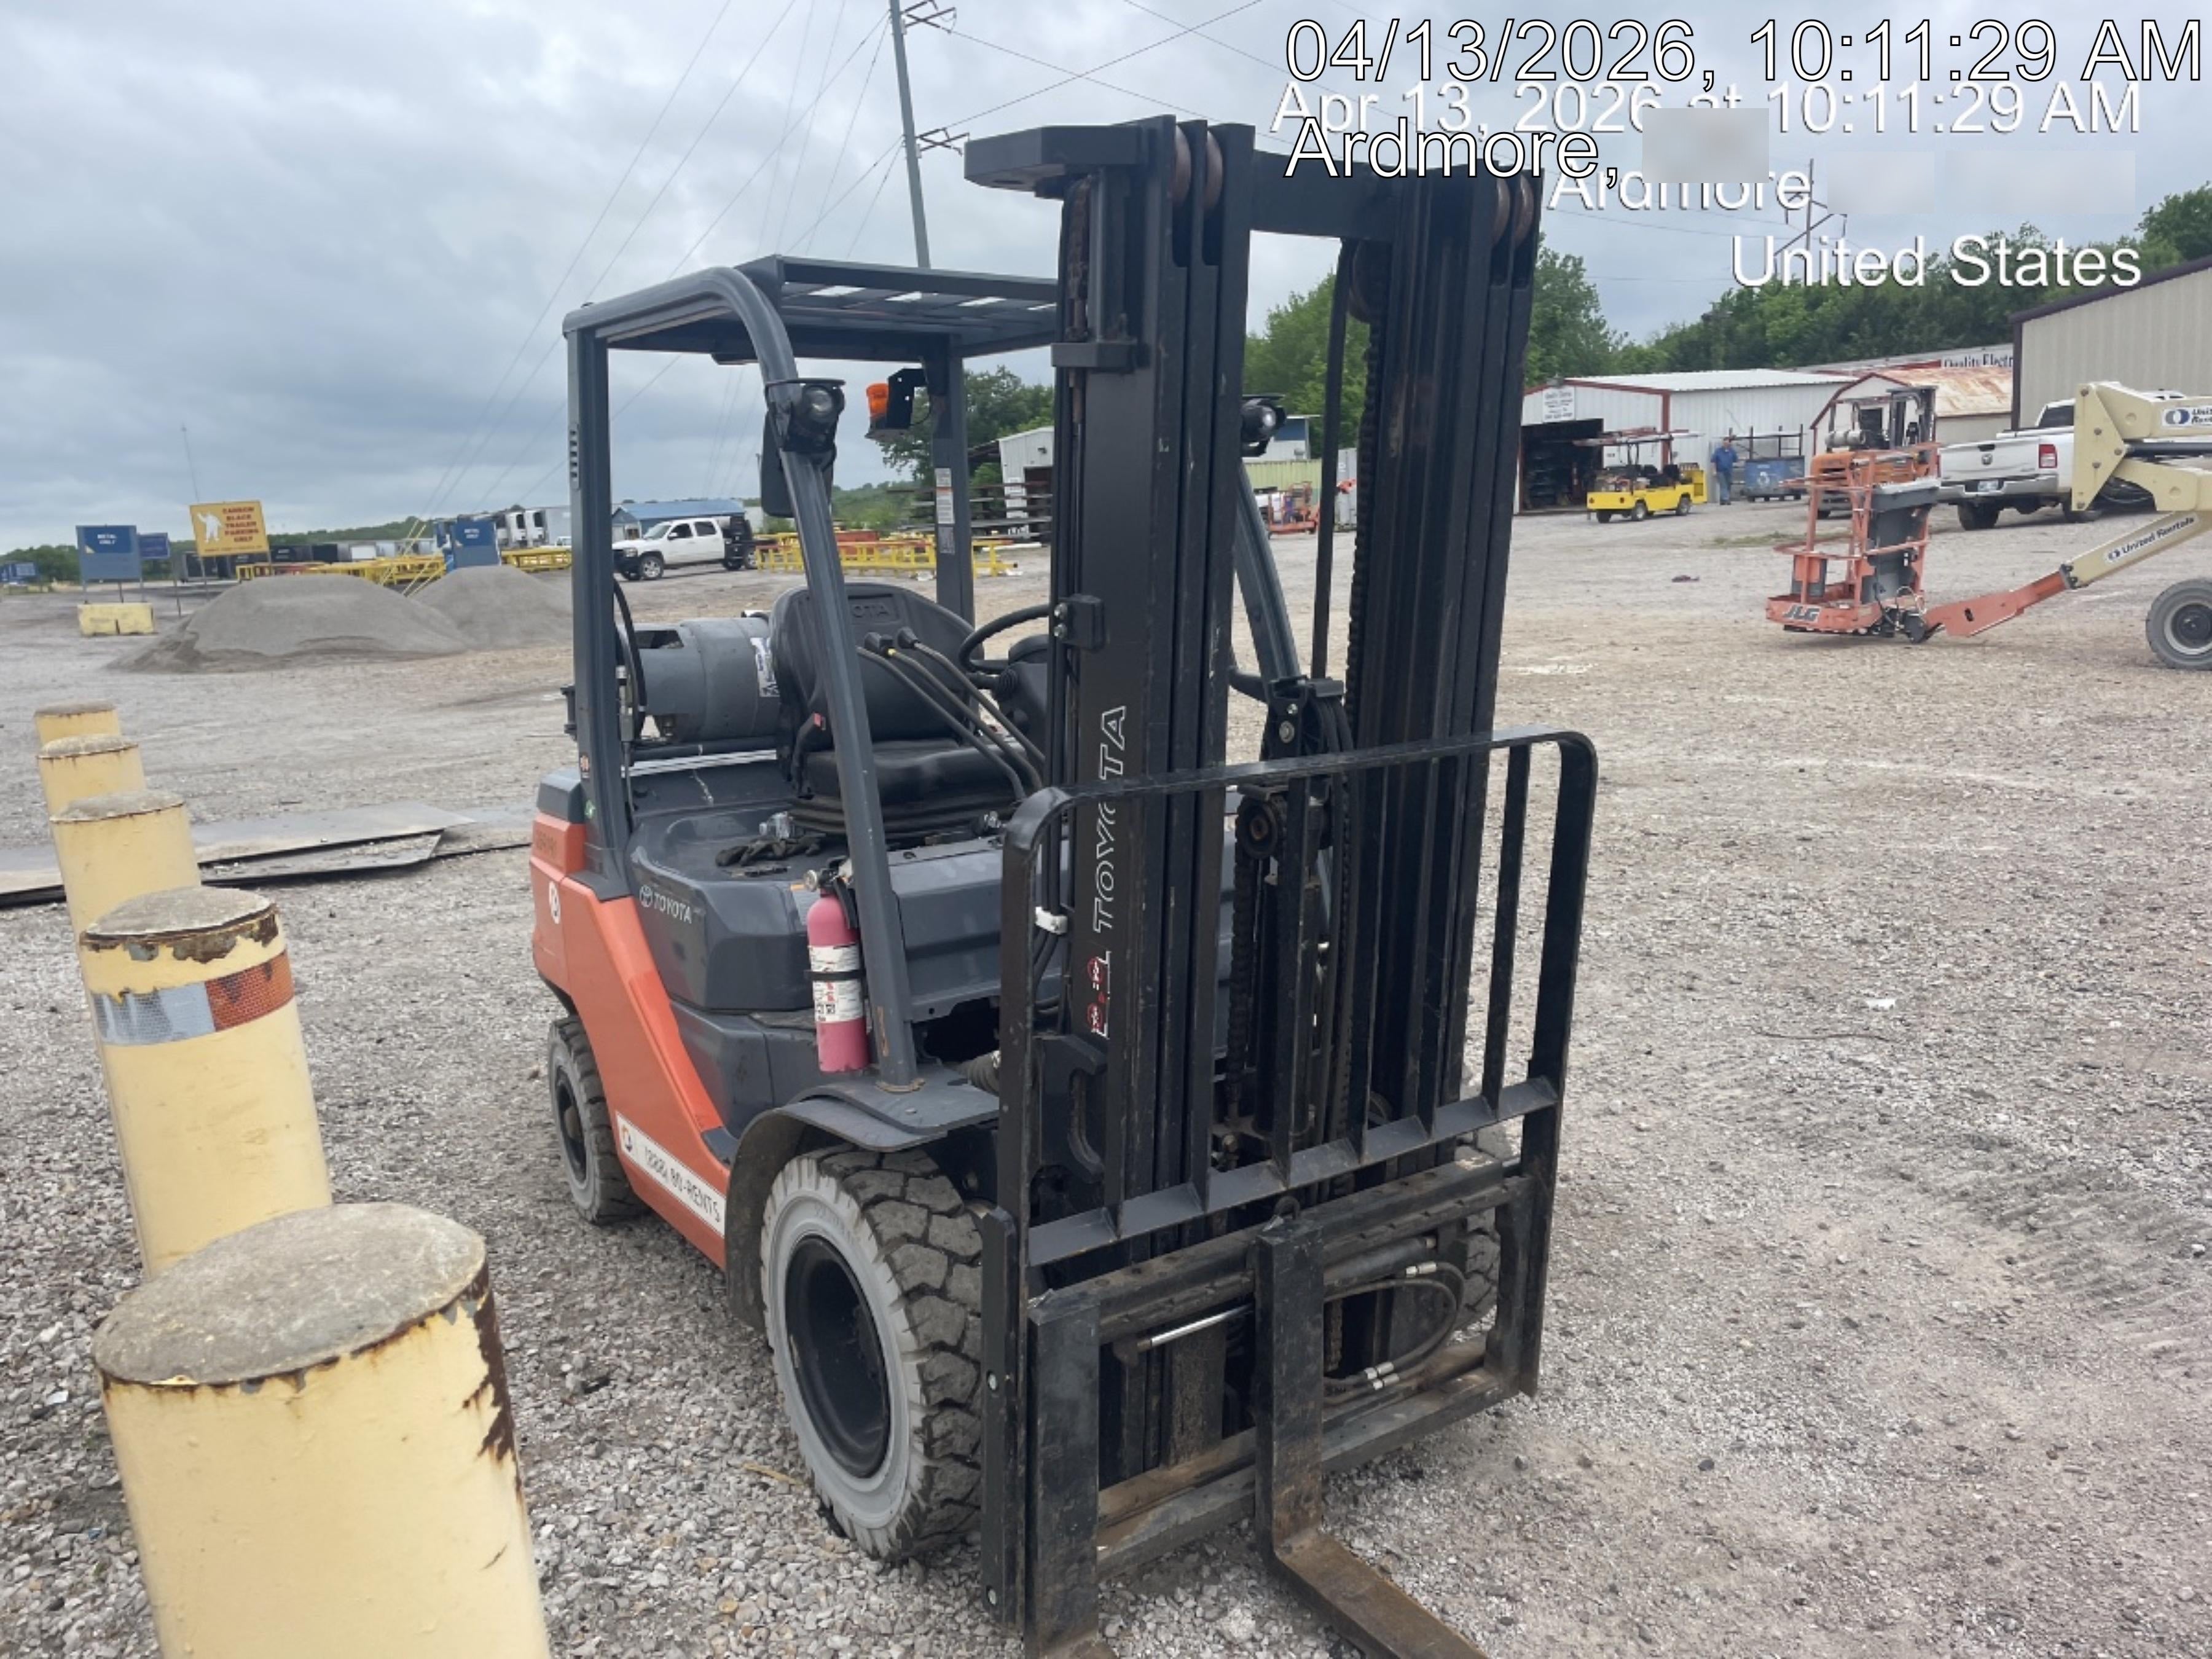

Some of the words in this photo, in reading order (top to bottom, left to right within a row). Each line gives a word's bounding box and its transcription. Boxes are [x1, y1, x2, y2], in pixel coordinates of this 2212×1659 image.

[2122, 532, 2155, 554] United
[2156, 517, 2195, 538] Rentals
[654, 892, 692, 924] TOYOTA
